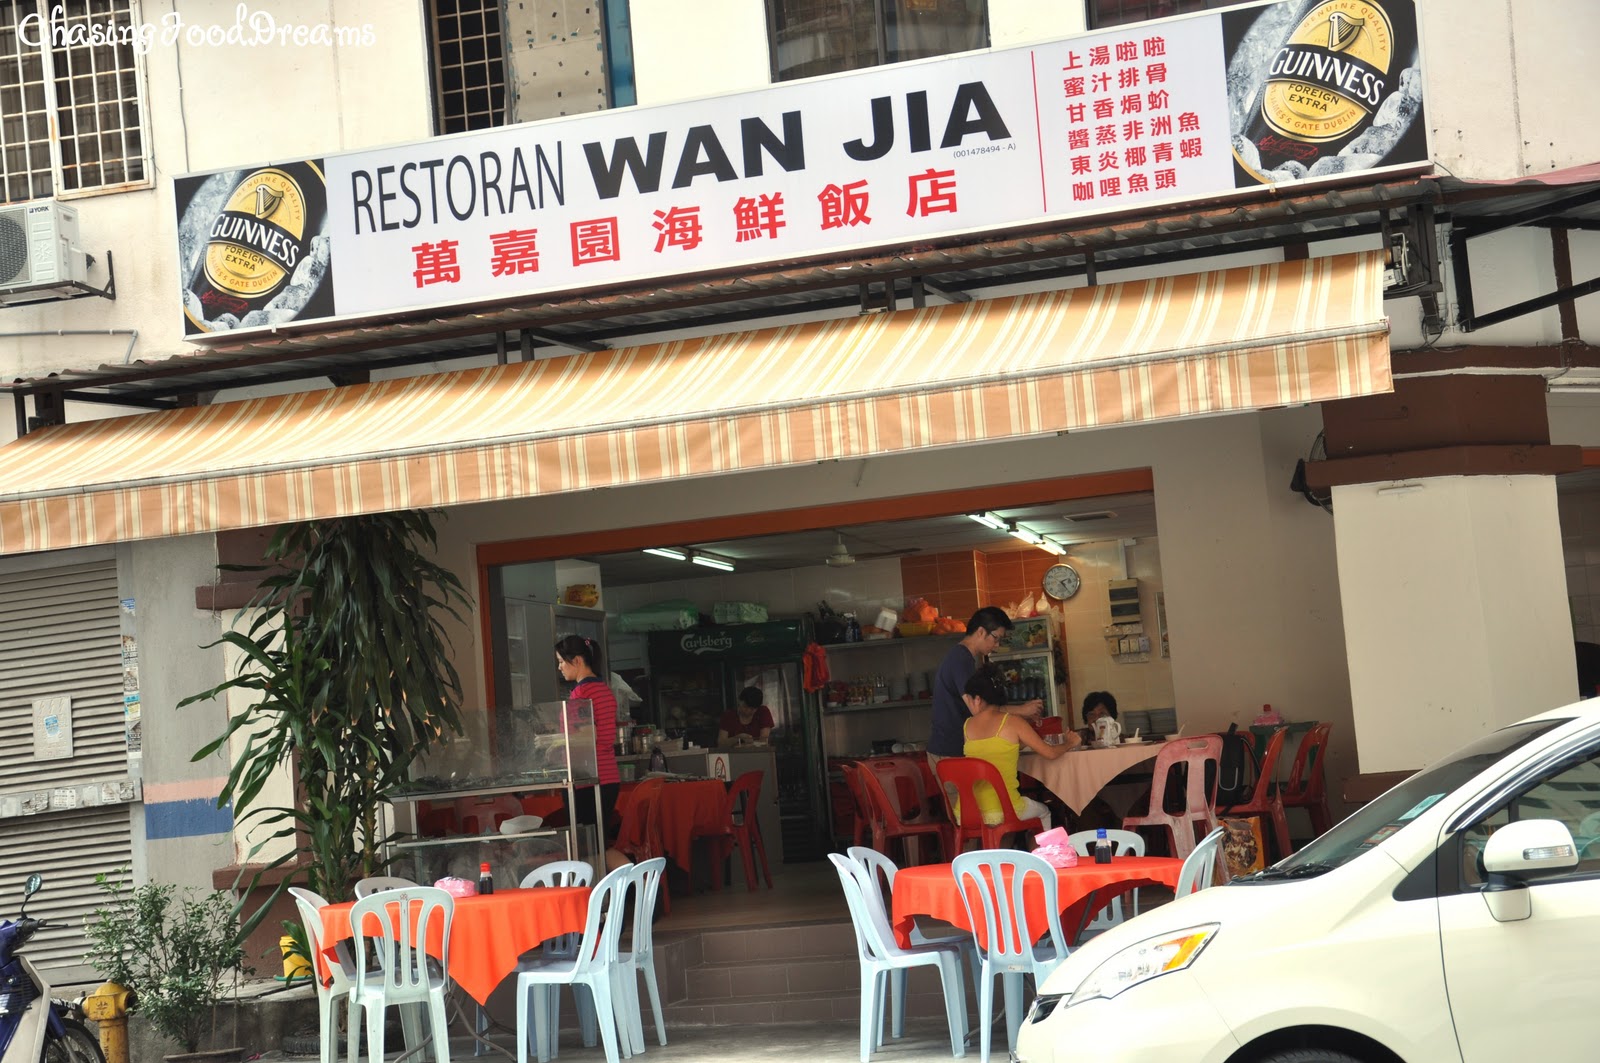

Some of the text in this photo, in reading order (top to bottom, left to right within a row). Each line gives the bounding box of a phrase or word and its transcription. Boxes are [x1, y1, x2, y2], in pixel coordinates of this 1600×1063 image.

[1303, 2, 1386, 51] GENUINE QUALITY
[1063, 36, 1166, 71] 上湯啦啦
[1064, 62, 1167, 98] 蜜汁排骨
[1269, 47, 1384, 105] GUINNESS
[1066, 89, 1169, 123] 甘香焗蚧
[1288, 83, 1339, 105] FOREIGN
[1289, 94, 1327, 112] EXTRA
[1068, 111, 1200, 150] 醬蒸非洲魚
[1294, 121, 1320, 131] GATE
[1323, 109, 1356, 130] DUBLIN
[351, 81, 1012, 235] RESTORAN WAN JIA
[1070, 137, 1202, 175] 東炎椰青蝦
[236, 177, 300, 221] GENUINE QUALITY
[1072, 168, 1177, 201] 咖哩魚頭
[210, 213, 299, 267] GUINNESS
[412, 168, 957, 289] 萬嘉園海鮮飯店
[225, 245, 265, 266] FOREIGN
[225, 254, 256, 271] EXTRA
[229, 278, 249, 287] GATE
[252, 270, 278, 287] DUBLIN
[680, 632, 732, 654] Carlsberg
